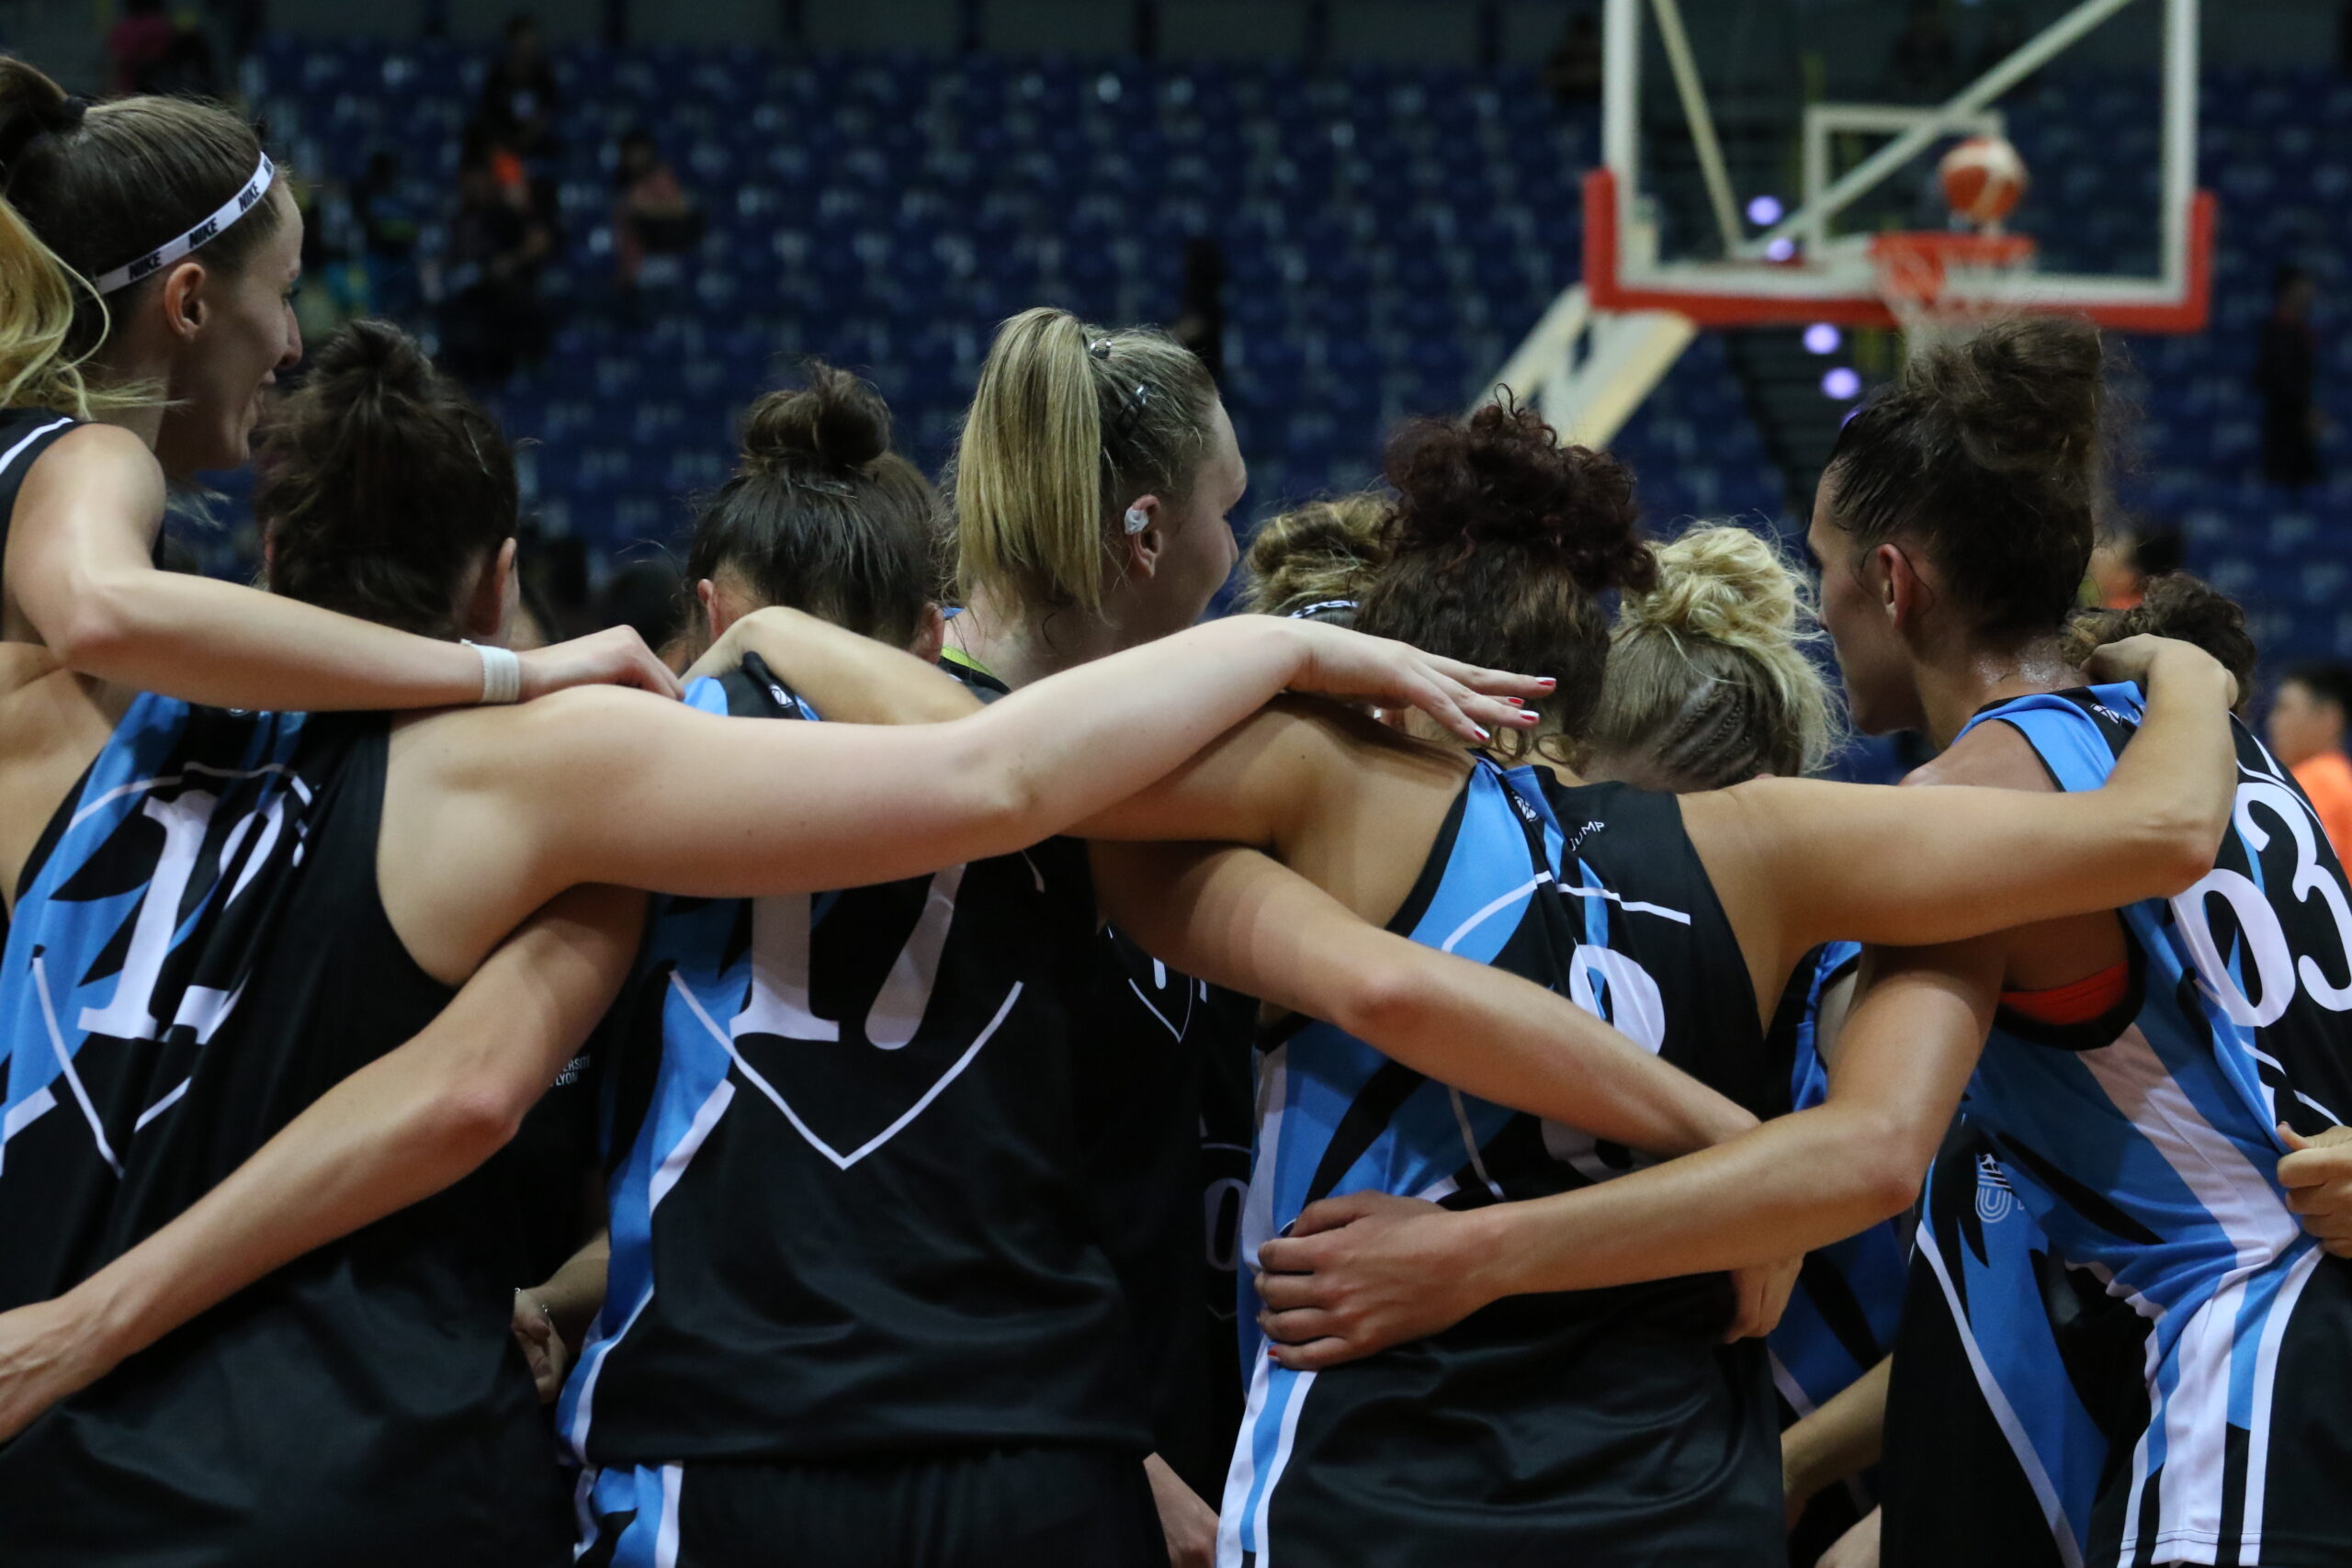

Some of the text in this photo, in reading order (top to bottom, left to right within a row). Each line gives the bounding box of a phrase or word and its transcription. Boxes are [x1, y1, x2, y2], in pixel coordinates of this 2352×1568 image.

[238, 181, 260, 212] NIKE
[189, 217, 218, 249] NIKE
[129, 251, 162, 281] NIKE
[1569, 820, 1605, 852] JUMP
[2170, 782, 2352, 1028] 03
[555, 1071, 579, 1087] LYON
